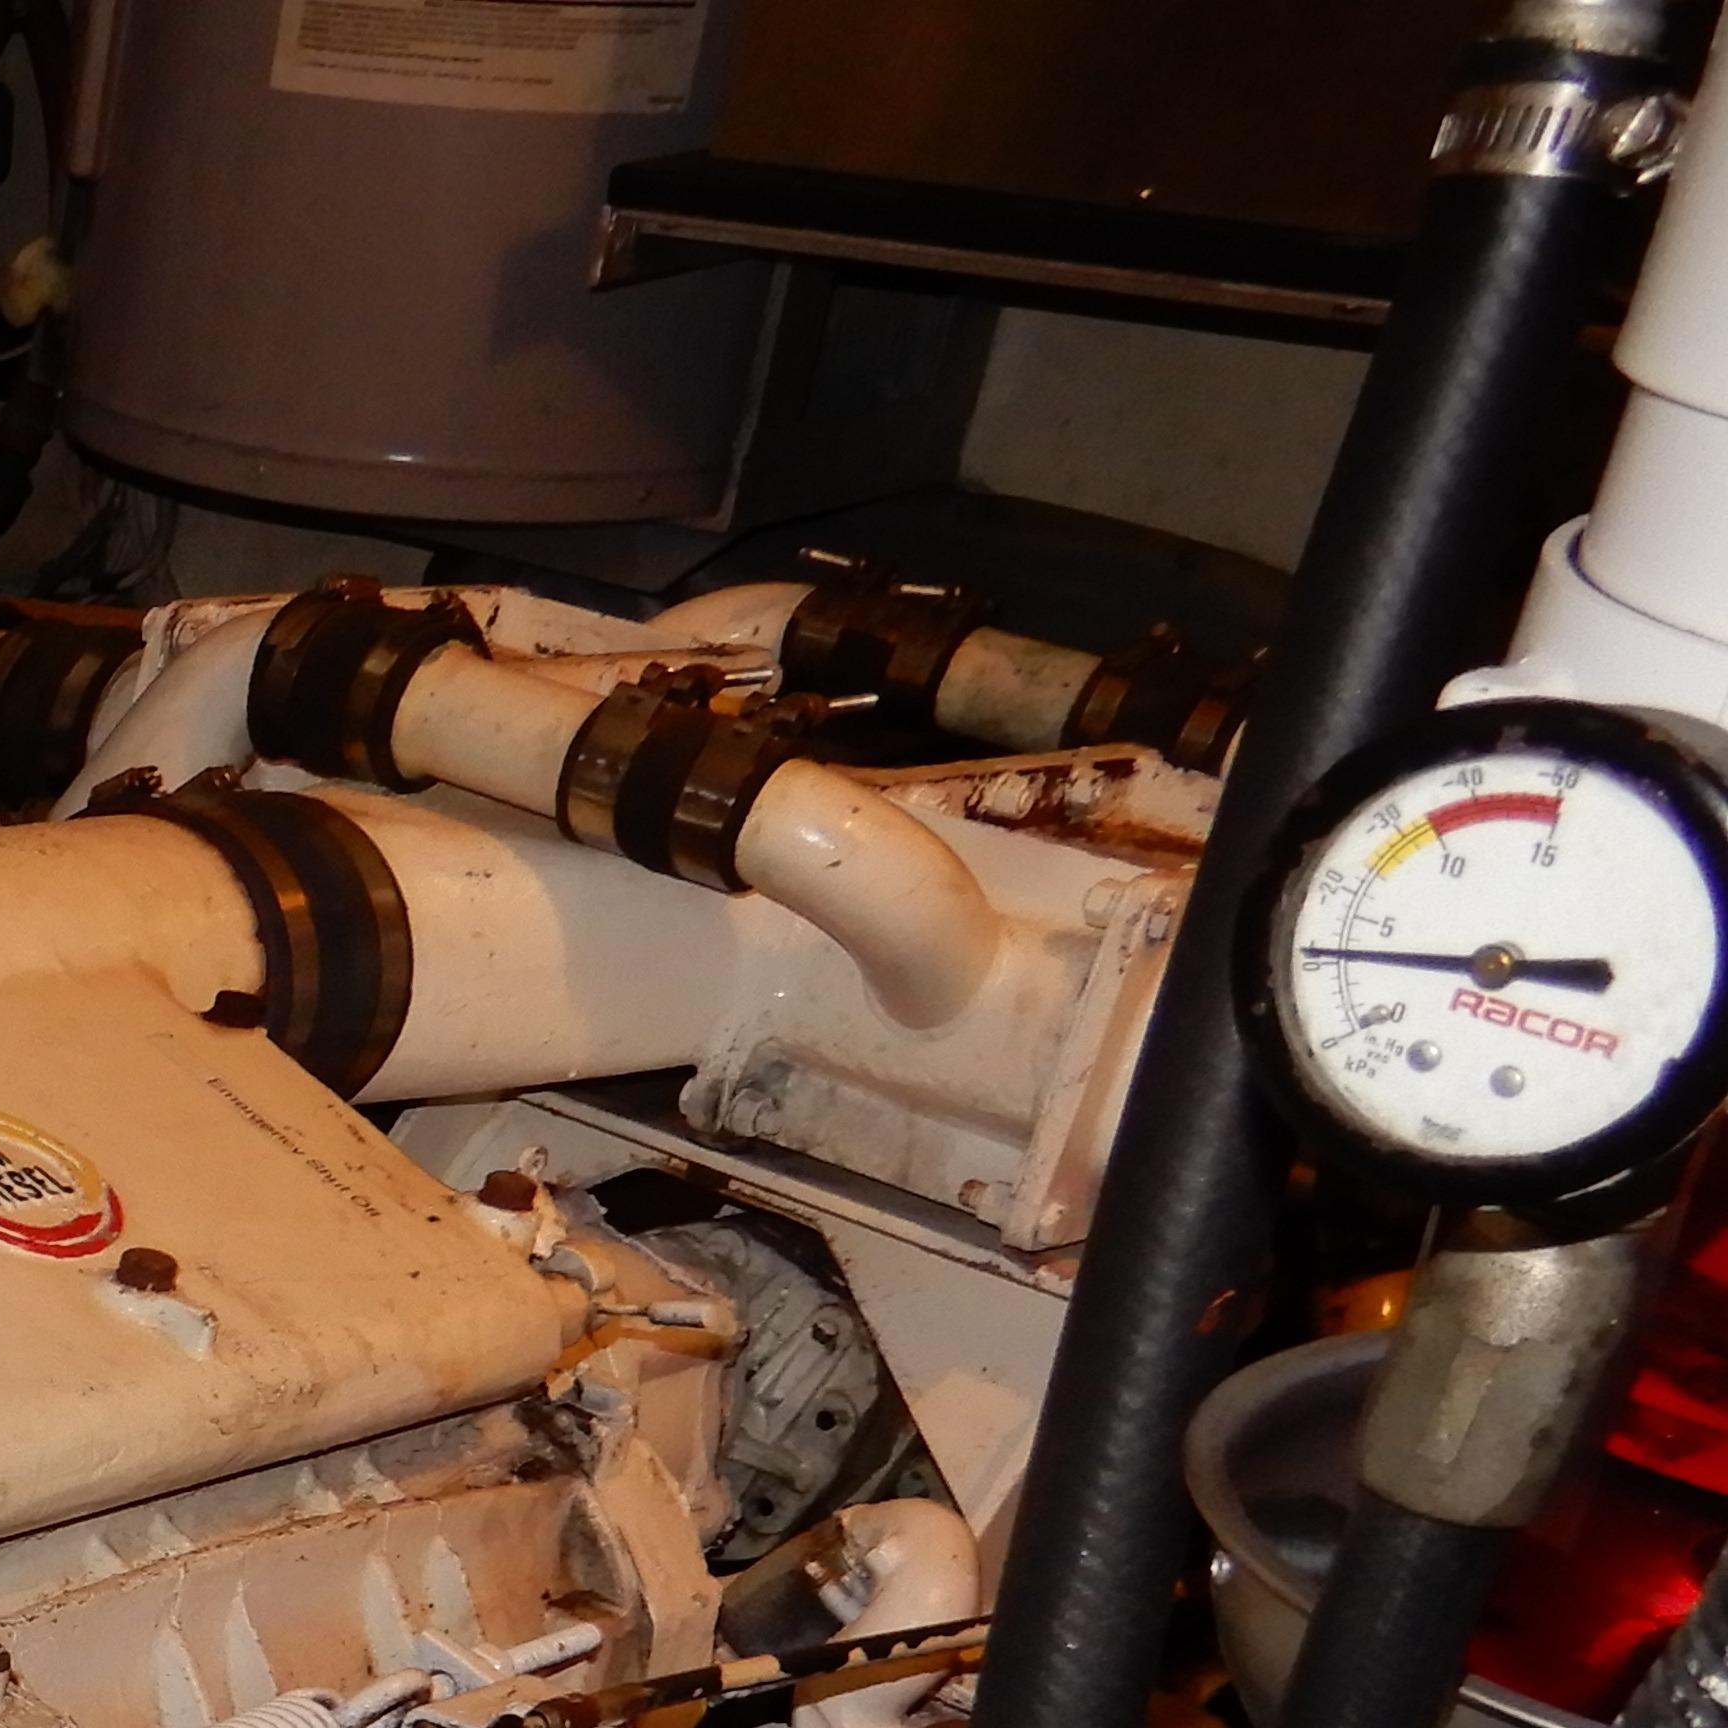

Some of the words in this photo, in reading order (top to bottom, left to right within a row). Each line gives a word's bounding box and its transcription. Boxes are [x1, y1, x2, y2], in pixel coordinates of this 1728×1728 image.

[1441, 766, 1484, 788] -40
[1366, 803, 1402, 835] -30
[1440, 851, 1466, 880] 10
[1531, 842, 1557, 867] 15
[1320, 869, 1344, 906] -20
[1380, 916, 1395, 938] 5
[1391, 1002, 1406, 1023] 0
[1321, 1037, 1338, 1049] 0
[1344, 1054, 1377, 1079] kPa
[205, 1076, 306, 1156] Emergency
[304, 1157, 352, 1192] Shut
